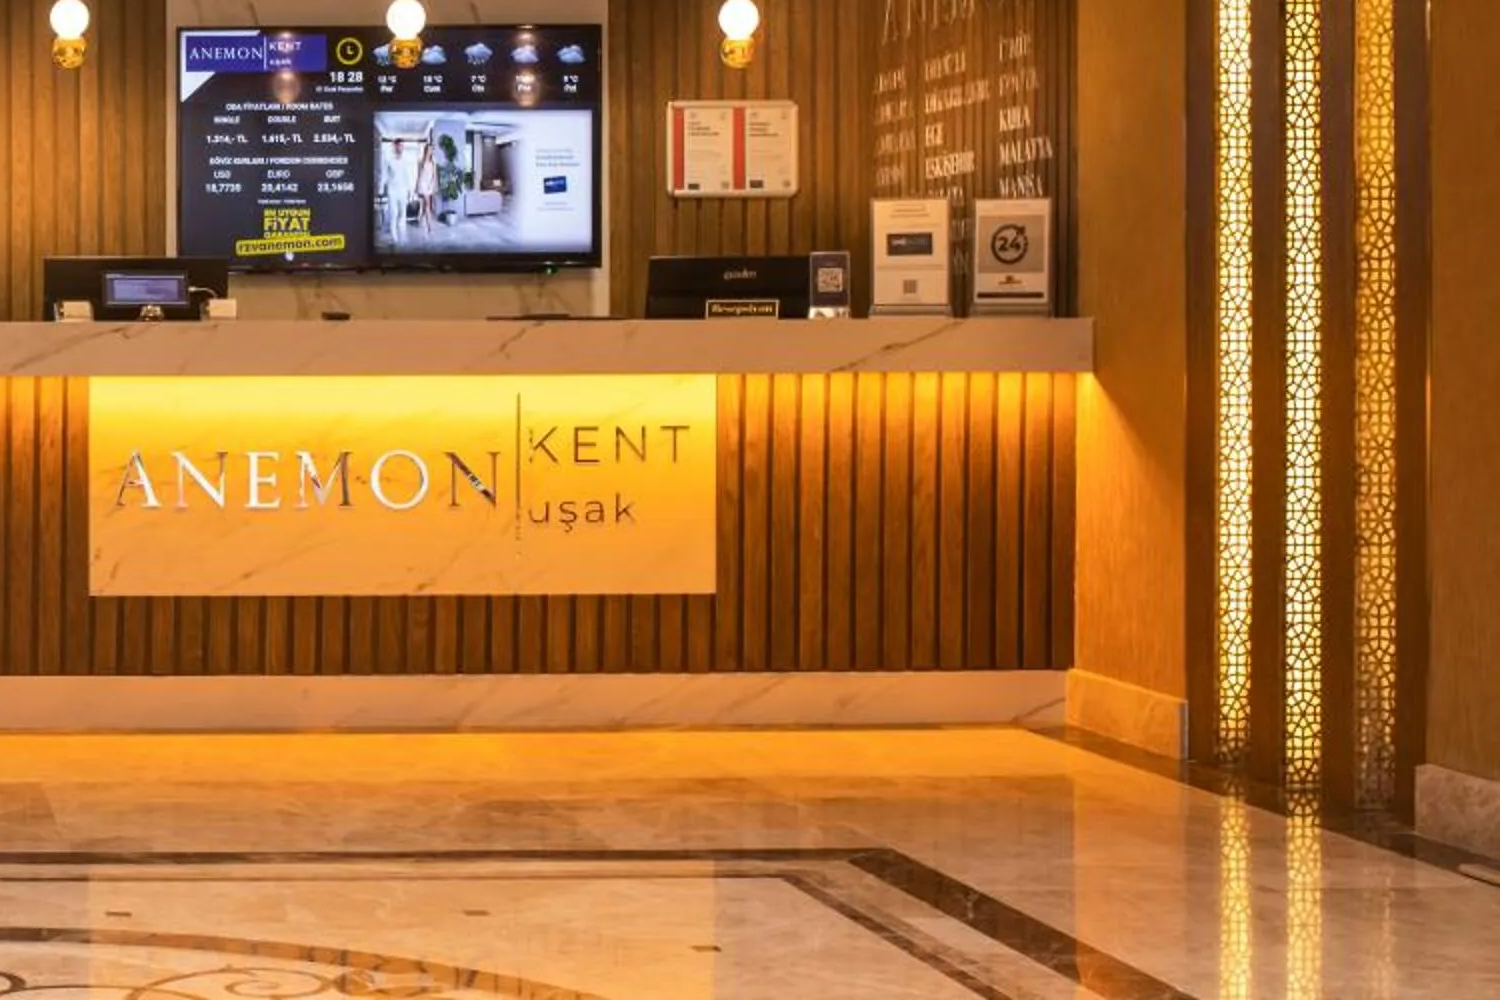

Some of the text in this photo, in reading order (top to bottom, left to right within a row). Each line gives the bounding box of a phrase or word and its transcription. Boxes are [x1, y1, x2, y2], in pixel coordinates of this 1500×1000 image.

[269, 41, 302, 51] KENT
[189, 47, 263, 60] ANEMON
[330, 71, 363, 83] 18 28
[998, 237, 1022, 252] 24
[116, 425, 691, 510] ANEMON KENT
[527, 493, 637, 532] uşak
